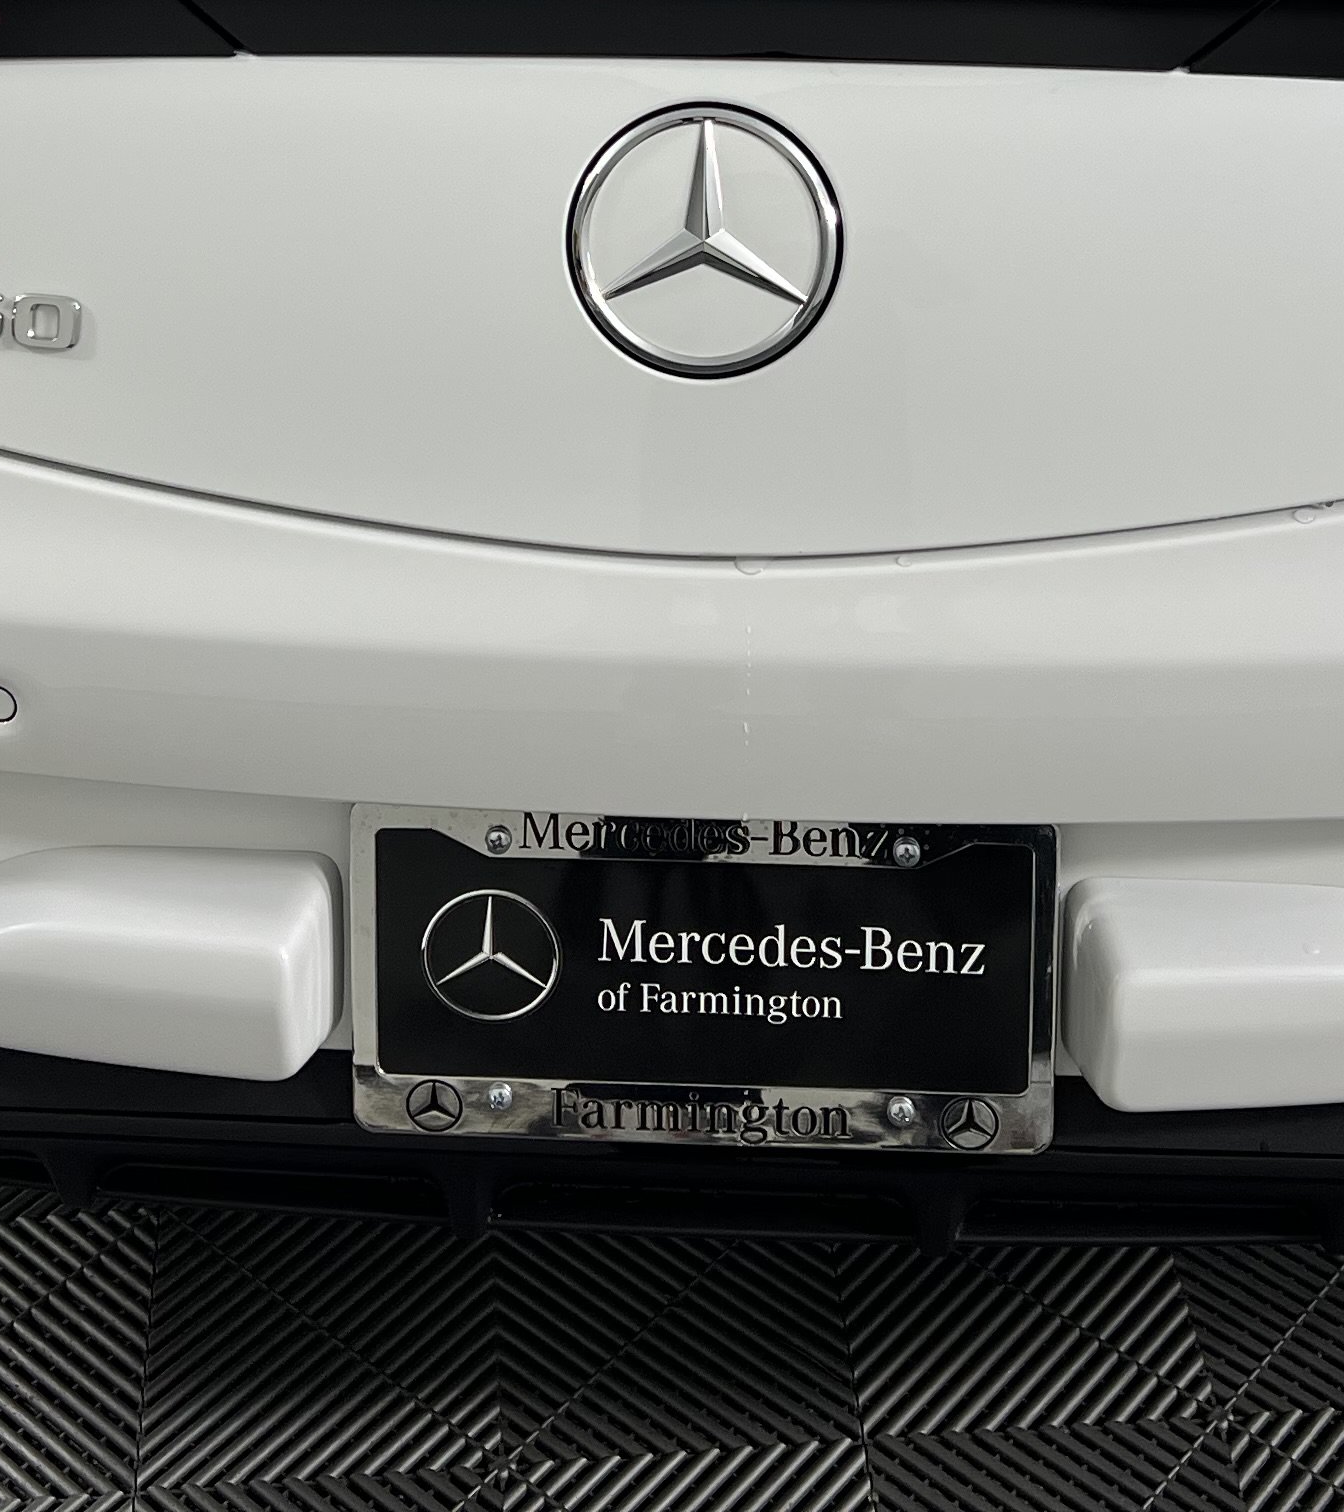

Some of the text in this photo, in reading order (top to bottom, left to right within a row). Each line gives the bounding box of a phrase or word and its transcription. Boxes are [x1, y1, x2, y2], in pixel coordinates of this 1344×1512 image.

[519, 811, 889, 859] Mercedes-Benz
[597, 918, 987, 976] Mercedes-Benz
[597, 982, 843, 1025] of Farmington
[552, 1088, 853, 1144] Farmington
